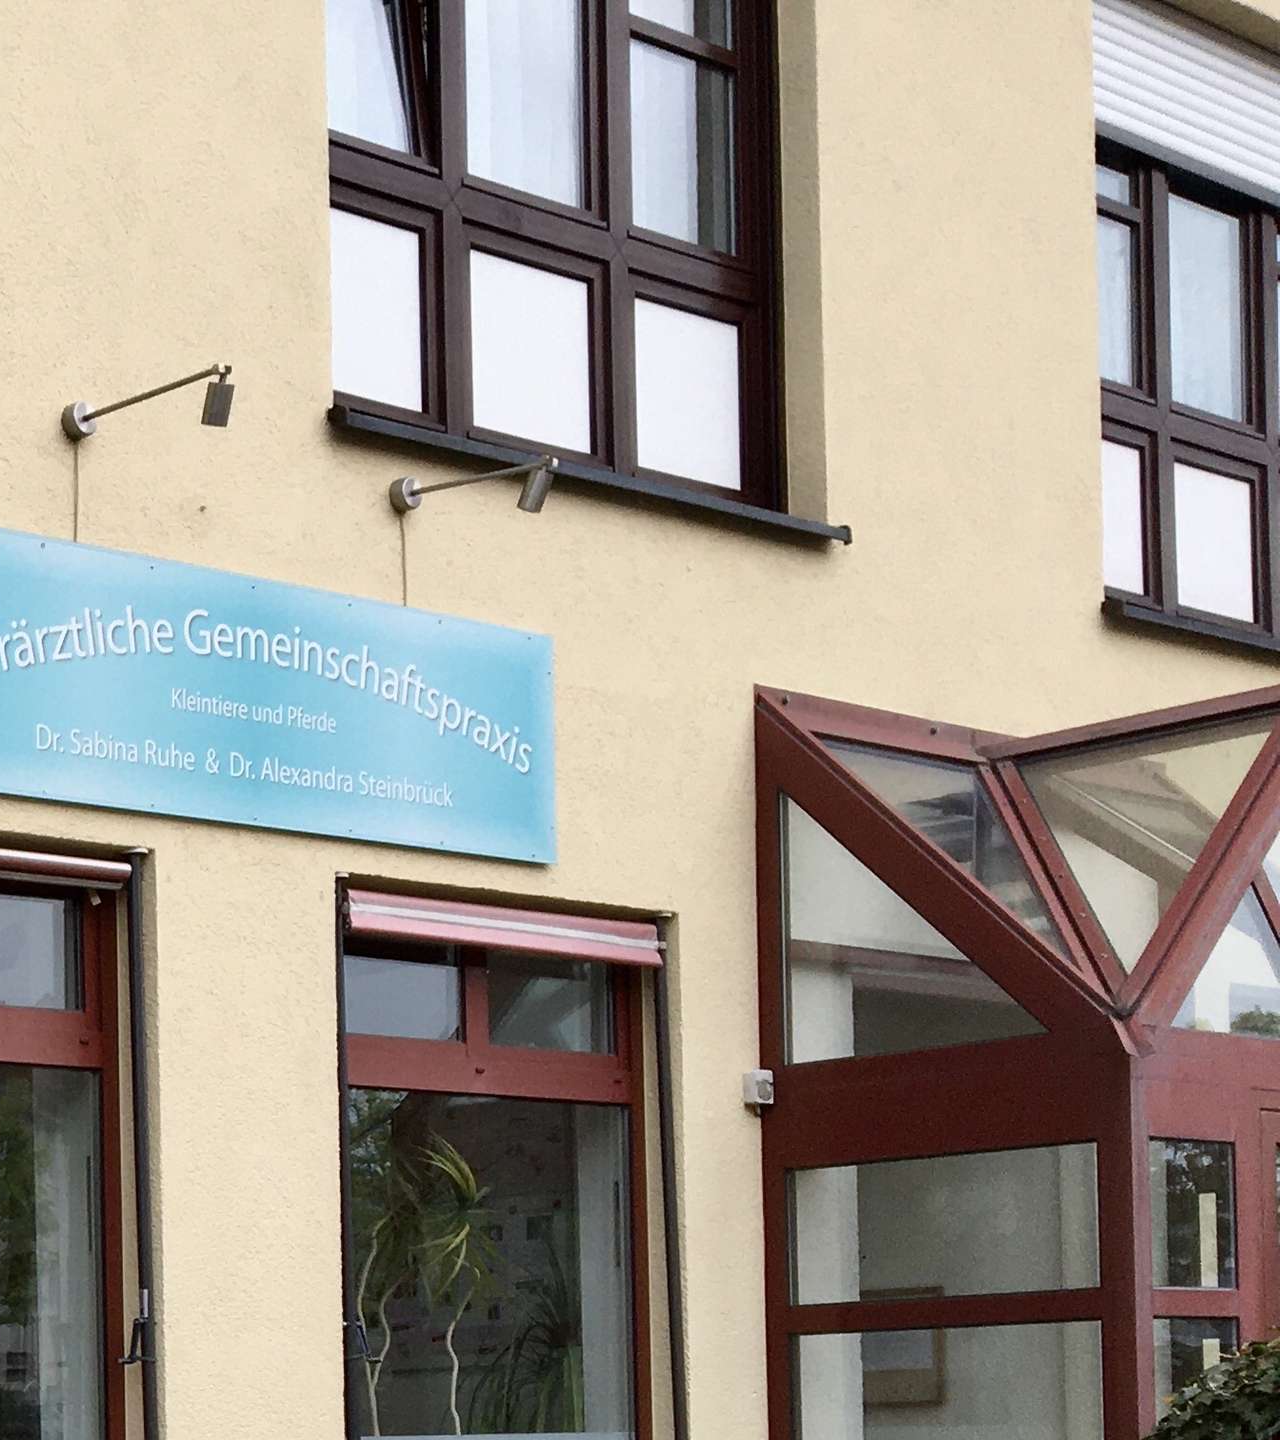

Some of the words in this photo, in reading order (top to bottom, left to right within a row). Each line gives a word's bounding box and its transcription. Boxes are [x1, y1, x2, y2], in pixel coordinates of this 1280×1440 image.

[171, 687, 248, 720] Kleintiere
[252, 704, 283, 726] und
[288, 706, 337, 733] Pferde
[183, 608, 533, 775] Gemeinschaftspraxis
[35, 723, 65, 753] Dr.
[70, 728, 138, 763] Sabina
[144, 740, 196, 771] Ruhe
[205, 748, 220, 774] &
[230, 752, 256, 780] Dr.
[260, 757, 353, 793] Alexandra
[359, 771, 454, 807] Steinbrück
